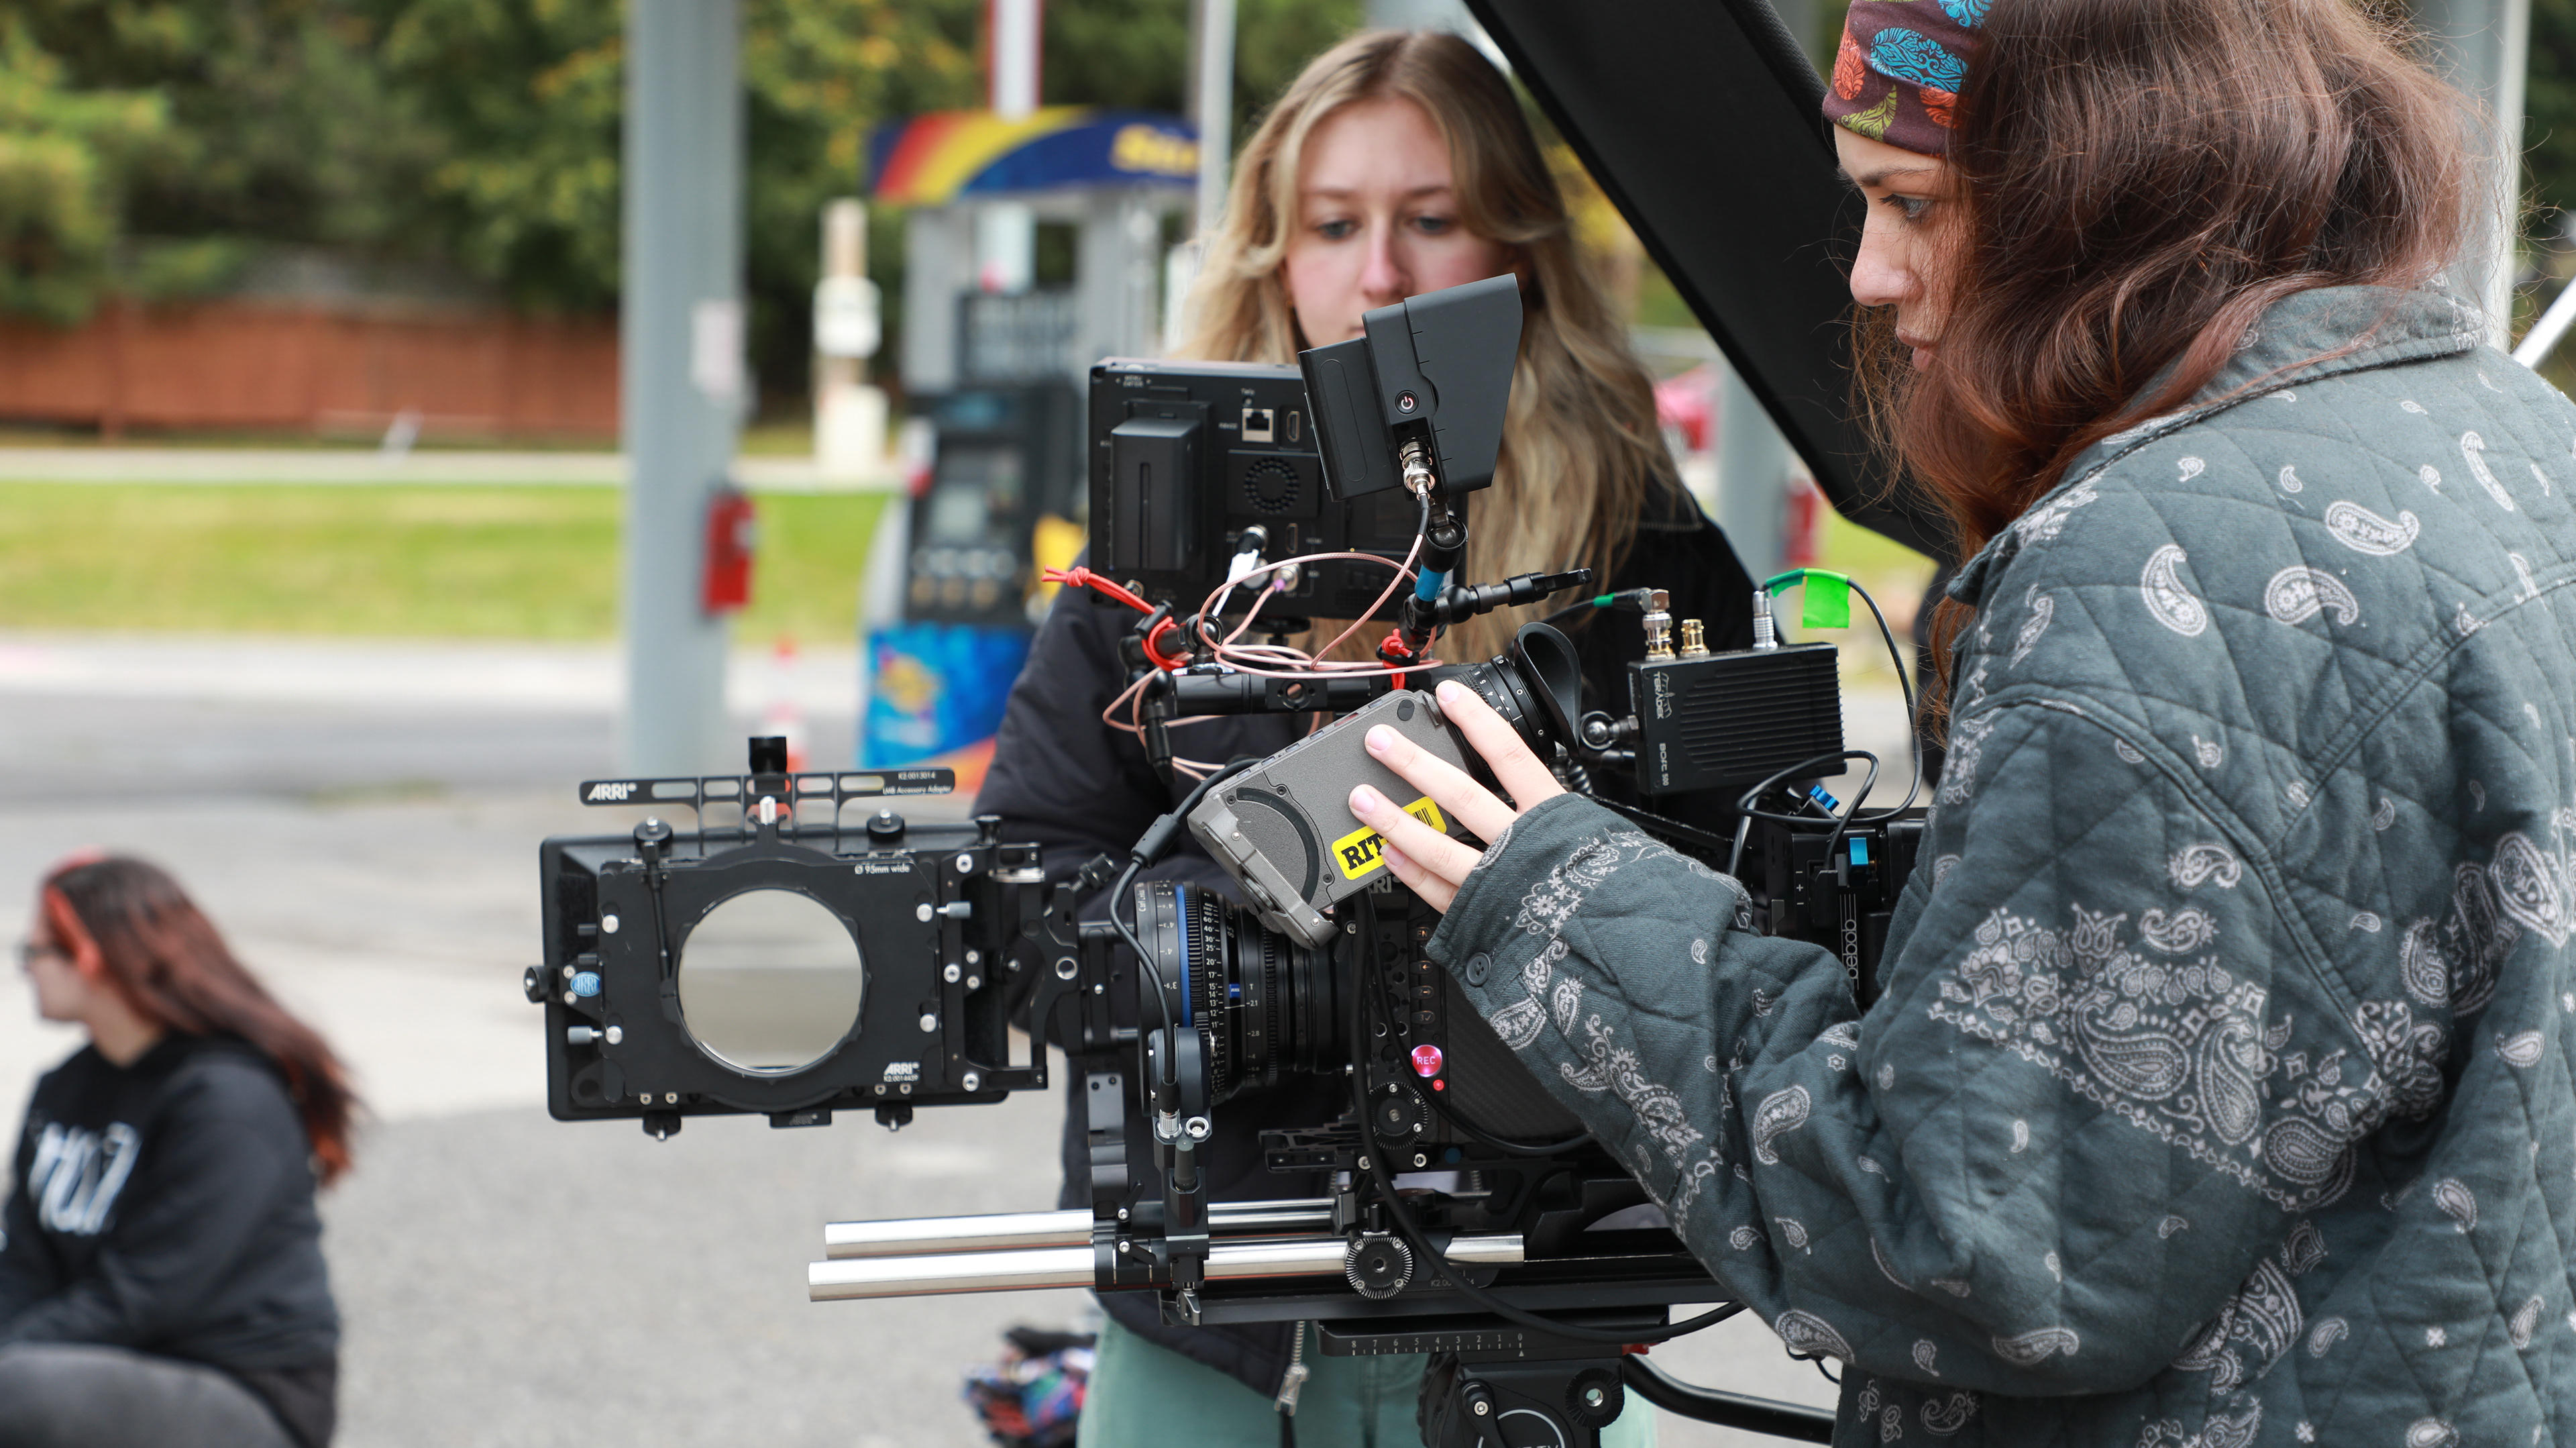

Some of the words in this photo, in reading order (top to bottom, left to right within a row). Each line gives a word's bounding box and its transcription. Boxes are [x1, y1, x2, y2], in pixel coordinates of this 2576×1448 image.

[1653, 671, 1664, 720] TERADEK
[587, 782, 629, 801] ARRI
[865, 863, 890, 874] 95mm
[891, 862, 910, 873] wide
[1416, 1055, 1436, 1066] REC
[883, 1062, 913, 1075] ARRI
[1517, 1333, 1523, 1341] 0
